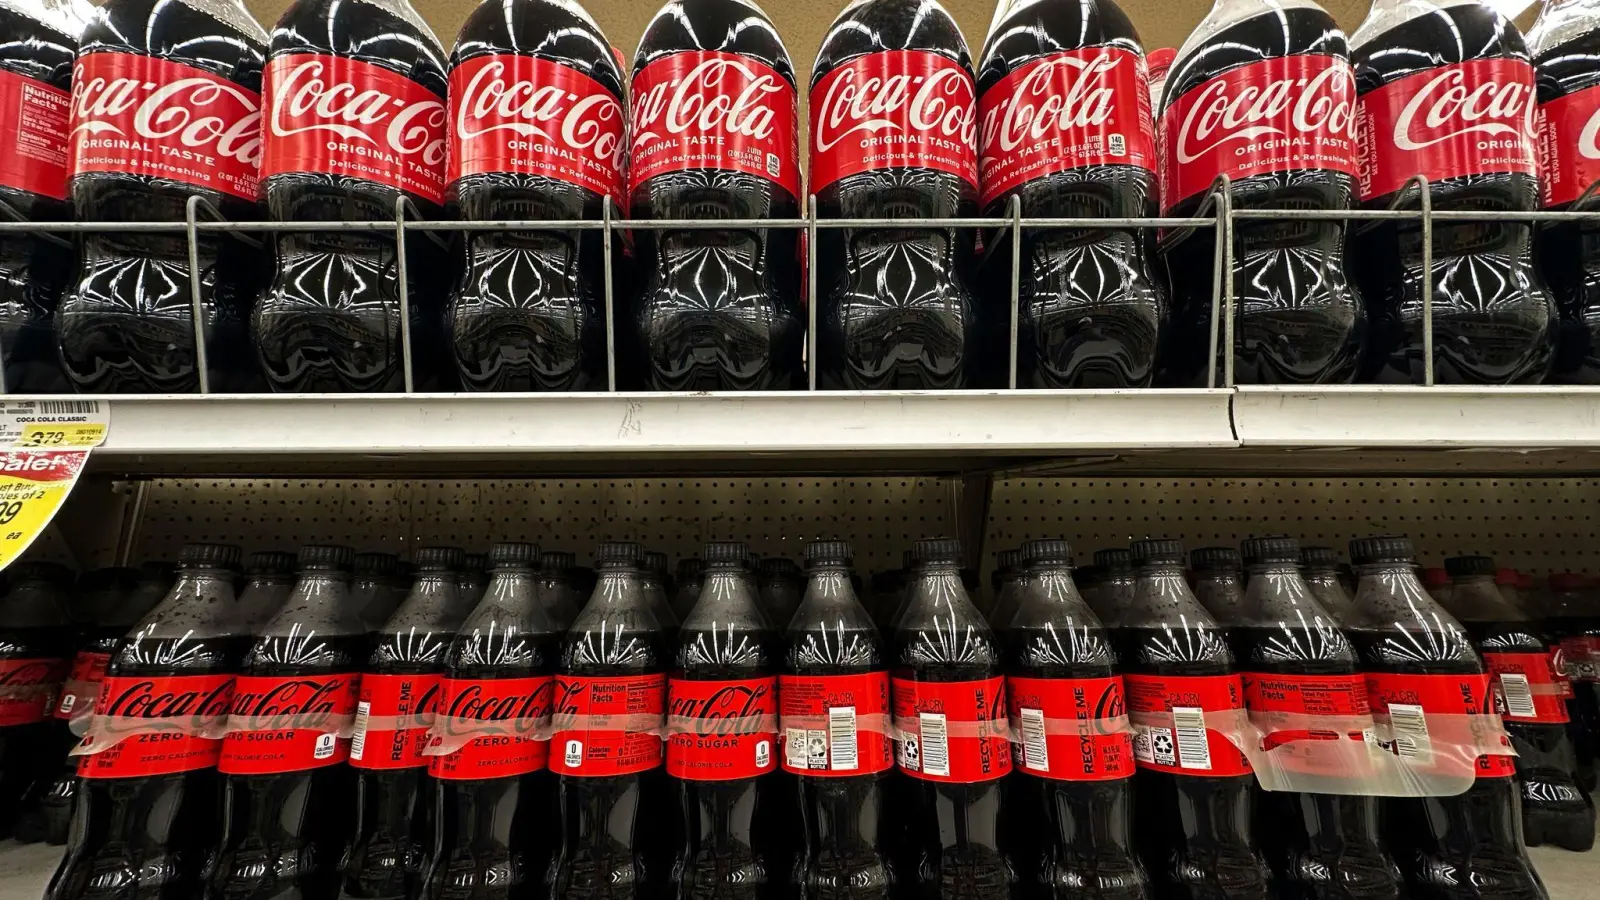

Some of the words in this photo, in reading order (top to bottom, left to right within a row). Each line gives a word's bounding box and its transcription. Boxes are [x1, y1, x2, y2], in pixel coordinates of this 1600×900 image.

[25, 85, 70, 108] Nutritio
[25, 93, 57, 110] Facts
[271, 60, 446, 166] Coca-Co
[81, 139, 153, 152] ORIGINAL
[159, 145, 216, 167] TASTE
[636, 138, 679, 164] ORIGINAL
[684, 136, 725, 145] TASTE
[860, 135, 925, 148] ORIGINAL
[929, 136, 961, 154] TASTE
[1018, 138, 1059, 158] TASTE
[1235, 136, 1310, 156] ORIGINAL
[1314, 136, 1349, 150] TASTE
[326, 141, 404, 167] ORIGINAL
[407, 160, 444, 185] TASTE
[507, 140, 577, 162] ORIGINAL
[580, 156, 612, 179] TASTE
[672, 153, 722, 163] Refreshing
[863, 153, 905, 163] Delicious
[918, 152, 960, 169] Refreshing
[1009, 156, 1058, 178] Refreshing
[1239, 155, 1289, 170] Delicious
[1303, 153, 1348, 165] Refreshing
[1357, 127, 1371, 197] RECYCLE
[130, 158, 138, 167] &
[142, 160, 211, 181] Refreshing
[329, 159, 380, 175] Delicious
[384, 170, 391, 178] &
[394, 174, 442, 199] Refreshing
[510, 158, 557, 171] Delicious
[569, 168, 611, 194] Refreshing
[21, 490, 37, 500] of
[36, 491, 46, 499] 2
[6, 532, 23, 540] ea
[592, 683, 626, 693] Nutrition
[1260, 680, 1298, 691] Nutrition
[1261, 690, 1285, 700] Facts
[592, 693, 613, 703] Facts
[974, 688, 985, 709] ME
[1073, 686, 1085, 708] ME
[391, 703, 409, 760] RECYCLE
[400, 681, 413, 701] ME
[138, 732, 184, 743] ZERO
[247, 731, 295, 741] SUGAR
[323, 736, 330, 746] 0
[474, 736, 509, 746] ZERO
[696, 739, 738, 748] SUGAR
[977, 712, 991, 774] RECYCLE
[1076, 710, 1094, 774] RECYCLE
[571, 743, 577, 754] 0
[760, 744, 766, 755] 0
